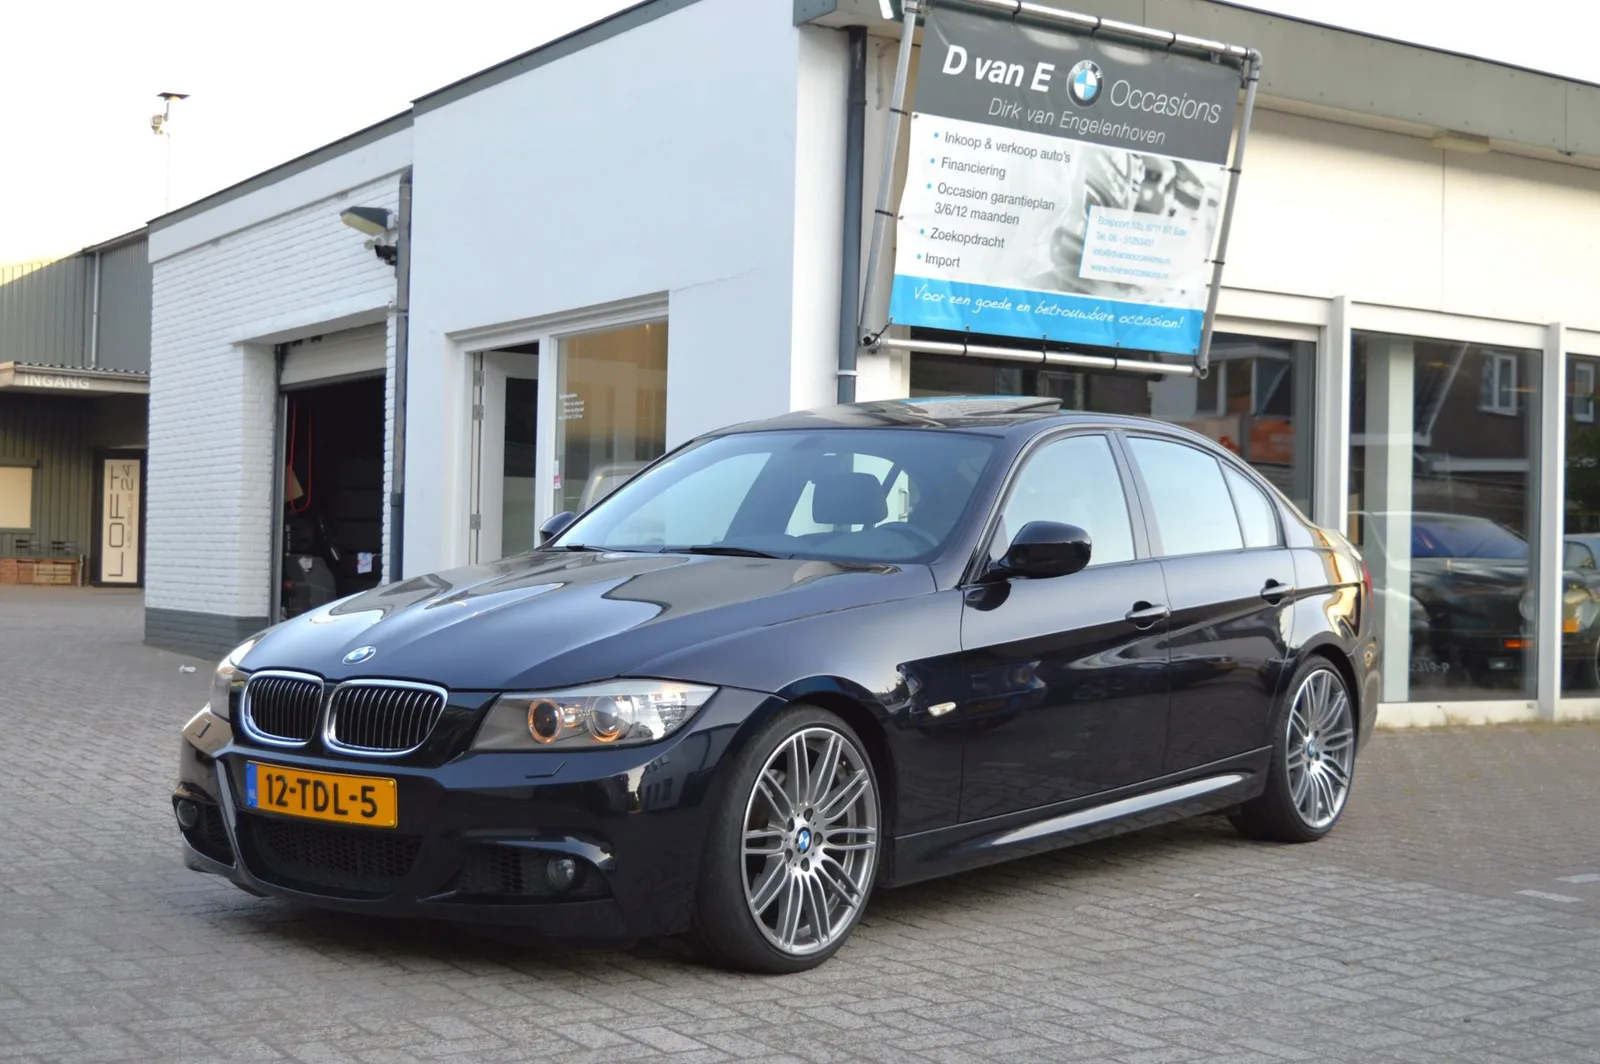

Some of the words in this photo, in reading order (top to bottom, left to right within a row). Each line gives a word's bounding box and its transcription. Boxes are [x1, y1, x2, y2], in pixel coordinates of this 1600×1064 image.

[942, 45, 968, 75] D
[974, 59, 1025, 87] van
[1031, 62, 1056, 93] E
[1110, 79, 1222, 125] Occasions
[988, 97, 1021, 120] Dirk
[1028, 108, 1054, 127] van
[1059, 111, 1166, 146] Engelenhoven
[944, 131, 982, 150] Inkoop
[984, 138, 992, 150] &
[996, 141, 1038, 160] verkoop
[1040, 149, 1071, 164] auto's
[941, 156, 1006, 180] Financiering
[937, 182, 988, 201] Occasion
[990, 191, 1055, 211] garantieplan
[934, 202, 968, 218] 3/6/12
[970, 208, 1020, 225] maanden
[930, 227, 1005, 249] Zoekopdracht
[925, 252, 961, 268] Import
[914, 283, 945, 301] Voor
[949, 295, 970, 306] een
[972, 297, 1012, 314] goede
[1016, 303, 1031, 312] en
[1034, 299, 1115, 322] betrouwbare
[1119, 314, 1185, 329] occasion!
[24, 374, 90, 389] INGANG
[121, 464, 134, 491] 24
[108, 464, 124, 577] LOFT
[266, 773, 378, 818] 12-TDL-5
